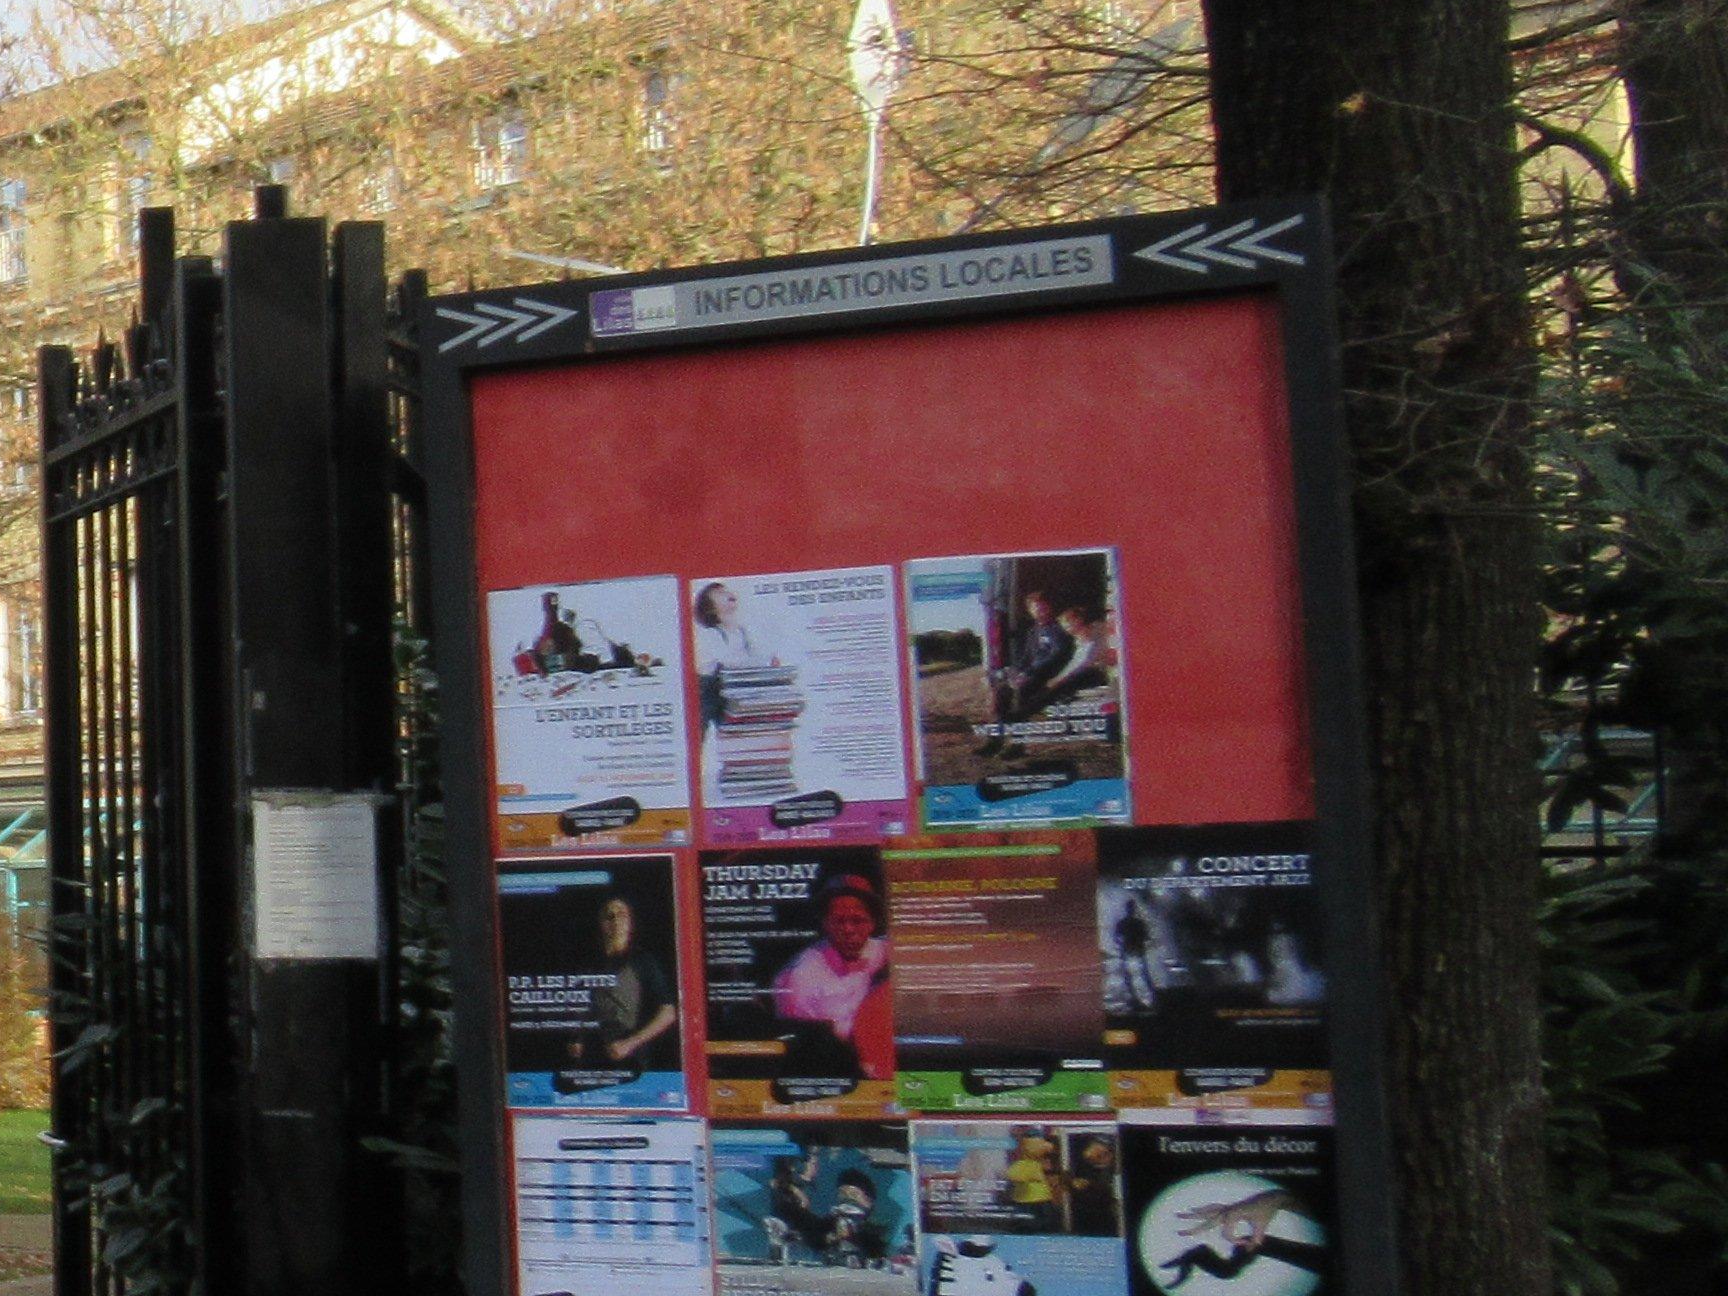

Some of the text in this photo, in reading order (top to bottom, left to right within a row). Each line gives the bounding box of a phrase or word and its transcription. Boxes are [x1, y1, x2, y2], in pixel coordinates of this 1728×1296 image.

[695, 246, 1094, 317] INFORMATIONS LOCALES
[534, 703, 673, 723] L'ENFANT ET LES
[1004, 720, 1068, 736] MISSED
[1069, 718, 1108, 733] YOU
[702, 863, 820, 882] THURSDAY
[1197, 853, 1310, 873] CONCERT
[703, 882, 809, 901] JAM JAZZ
[536, 974, 565, 988] LES
[567, 973, 618, 988] P'TITS
[508, 990, 592, 1005] CAILLOUX
[1158, 1135, 1319, 1153] l'envers du décor
